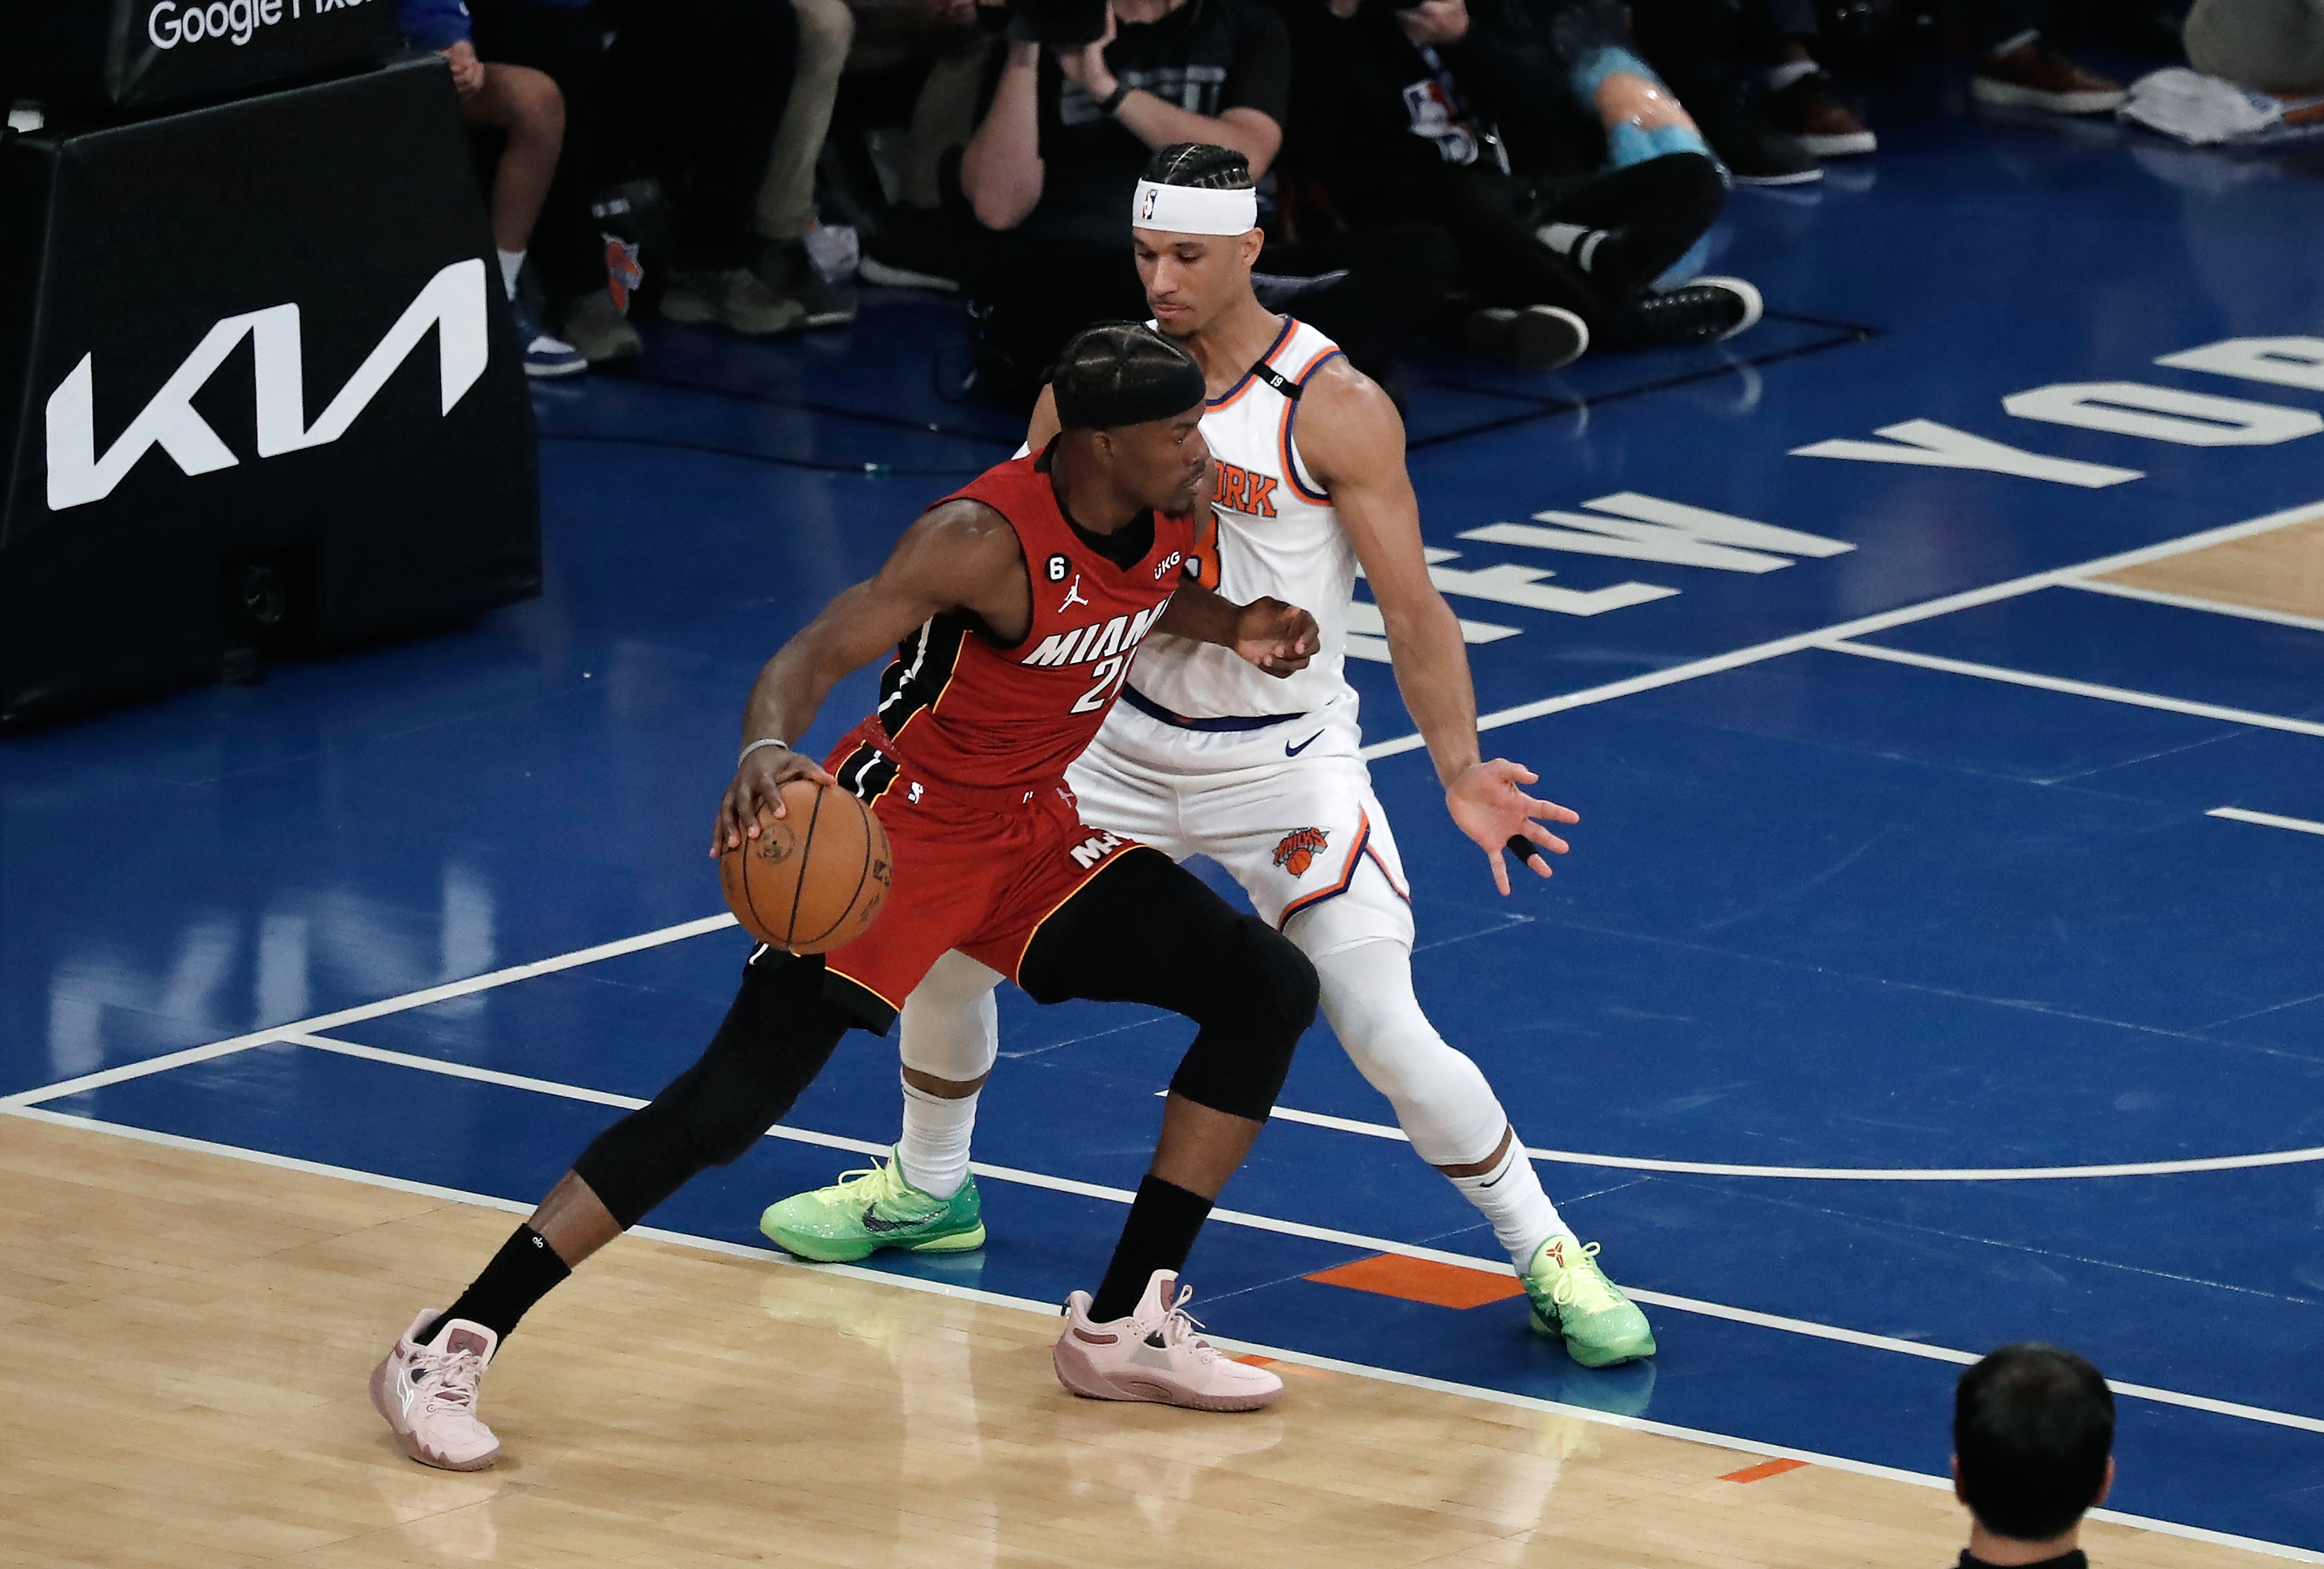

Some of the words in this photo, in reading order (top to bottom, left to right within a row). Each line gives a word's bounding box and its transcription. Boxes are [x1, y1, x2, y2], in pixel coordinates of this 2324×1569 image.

[148, 0, 283, 49] Google
[46, 258, 489, 511] KIA
[1270, 375, 1284, 387] 19
[1049, 556, 1065, 580] 6
[1069, 646, 1138, 714] 2
